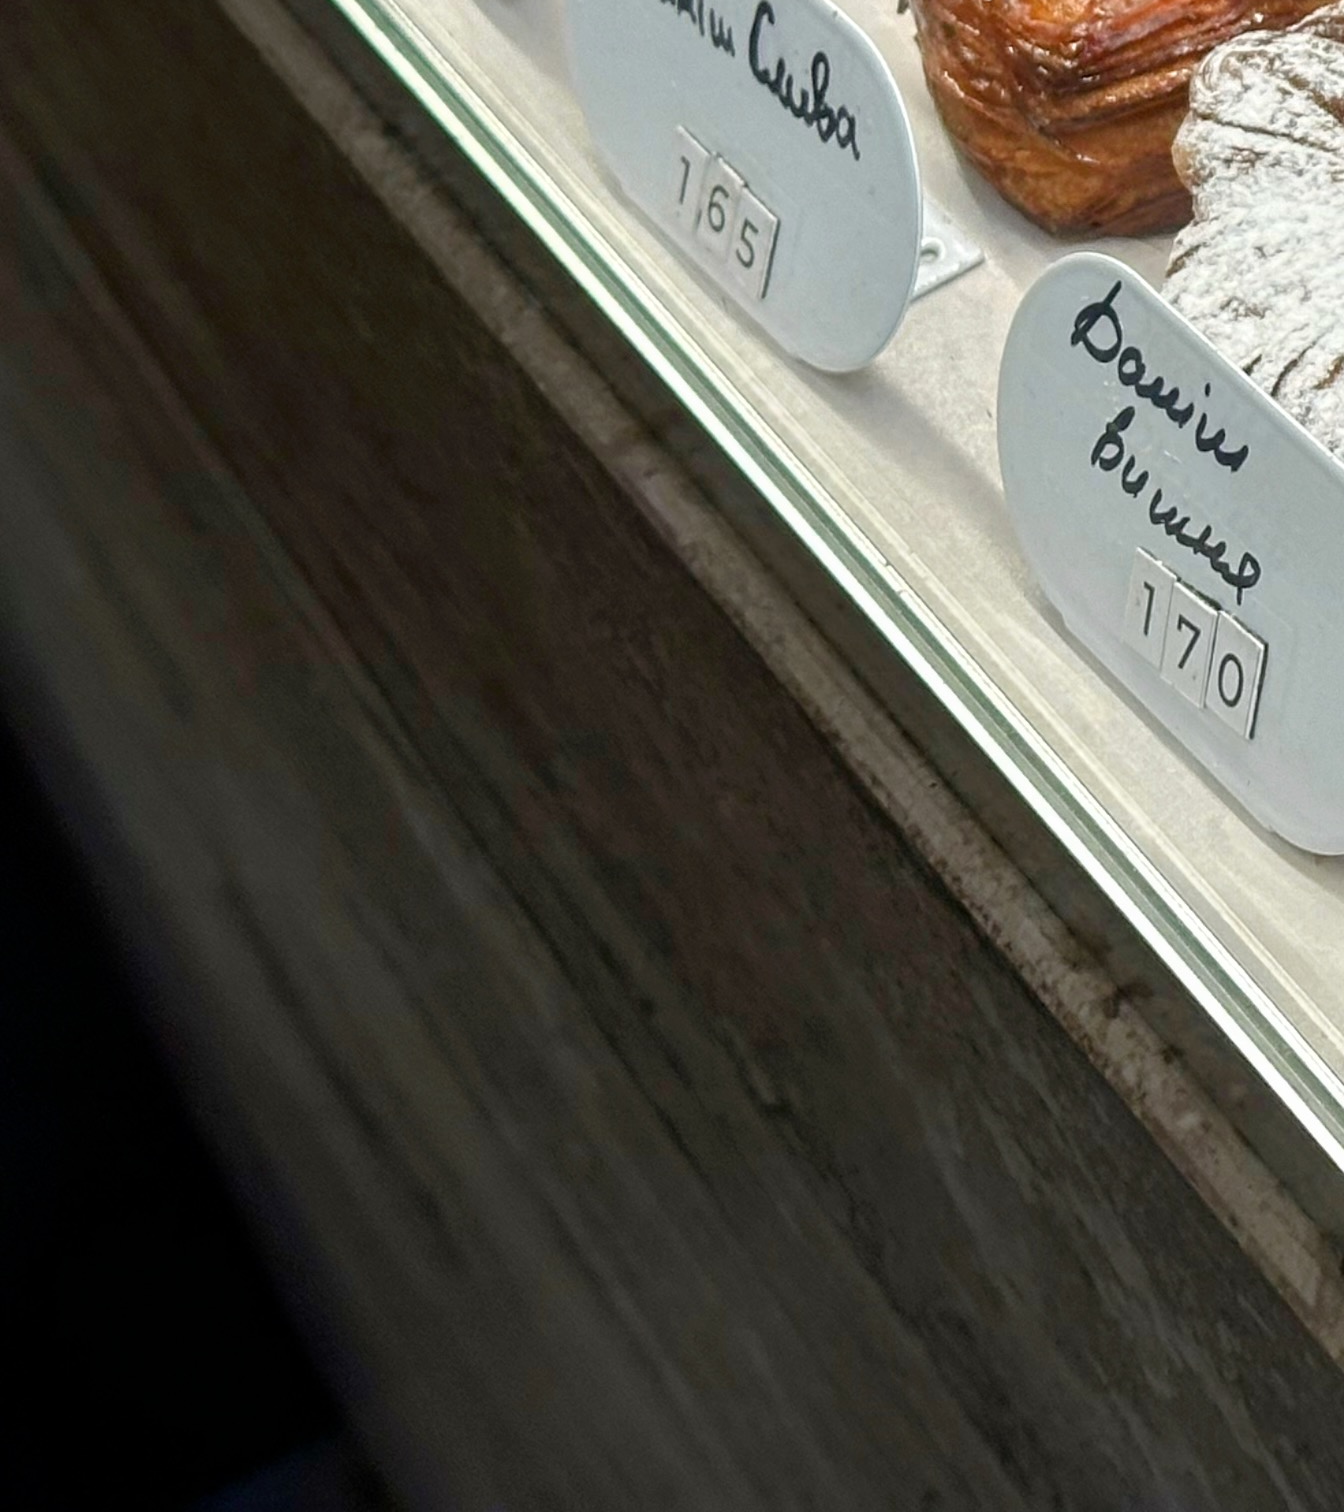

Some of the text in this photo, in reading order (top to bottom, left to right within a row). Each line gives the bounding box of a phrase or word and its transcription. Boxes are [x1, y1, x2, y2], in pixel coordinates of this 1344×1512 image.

[749, 0, 860, 161] Слива
[677, 156, 760, 268] 165
[1071, 281, 1249, 472] Даніш
[1141, 582, 1244, 708] 170
